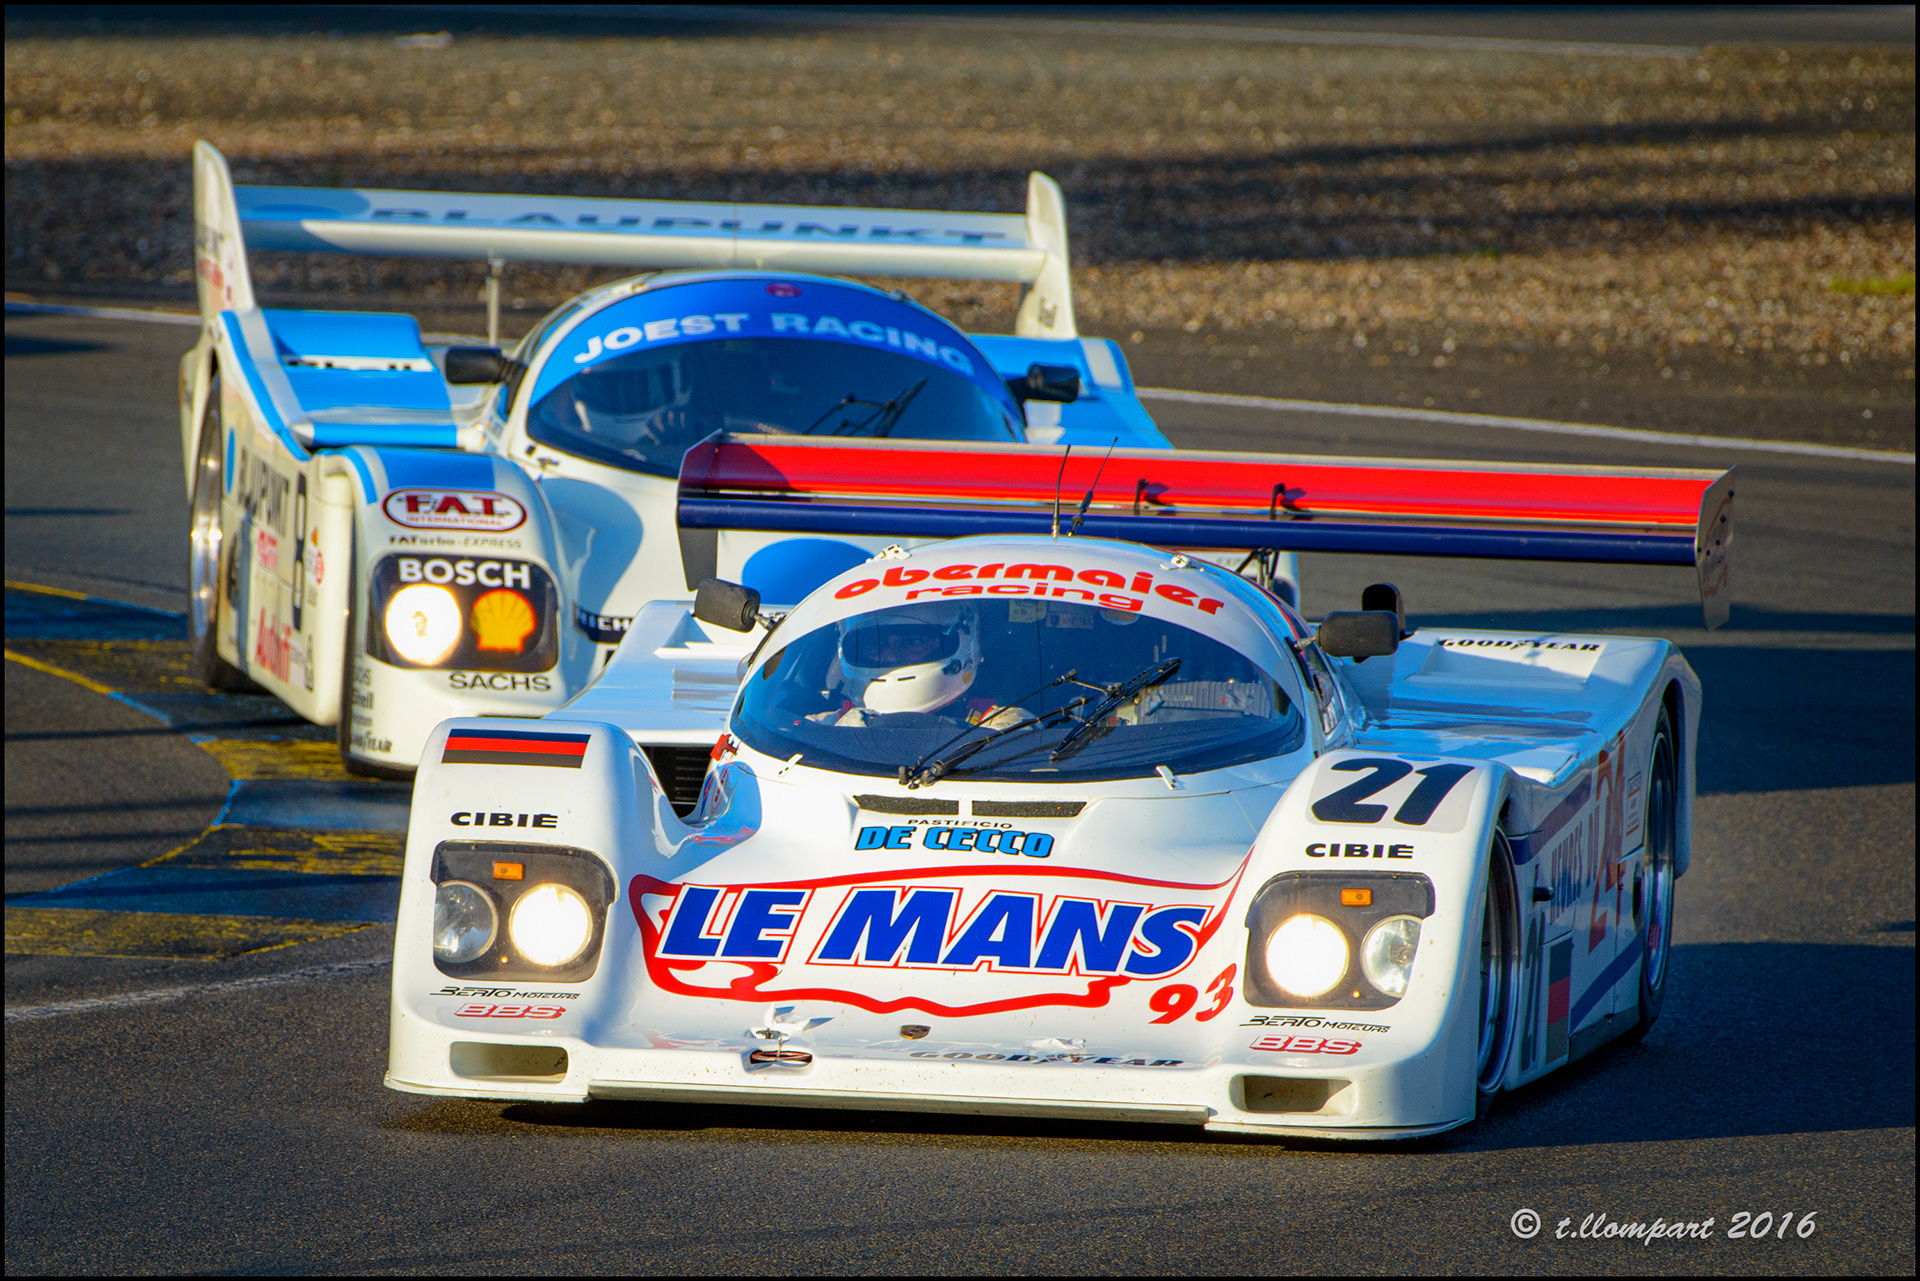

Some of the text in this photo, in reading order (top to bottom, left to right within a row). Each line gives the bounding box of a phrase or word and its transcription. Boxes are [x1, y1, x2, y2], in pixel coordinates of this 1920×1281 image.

[371, 208, 1006, 243] BLAUPUNKT
[574, 312, 749, 363] JOEST
[770, 312, 975, 376] RACING
[406, 515, 502, 527] INTERNATIONAL
[399, 558, 531, 590] BOSCH
[834, 563, 1225, 615] obermaier
[906, 582, 1144, 612] racing
[449, 671, 552, 692] SACHS
[1311, 758, 1476, 826] 21
[907, 819, 1013, 829] PASTIFICIO
[854, 826, 1055, 859] DE CECCO
[657, 884, 1210, 980] LE MANS
[430, 985, 517, 998] BERTO
[1149, 962, 1237, 1025] 93
[454, 1002, 567, 1020] BBS
[1239, 1015, 1326, 1028] BERTO
[1249, 1034, 1362, 1055] BBS
